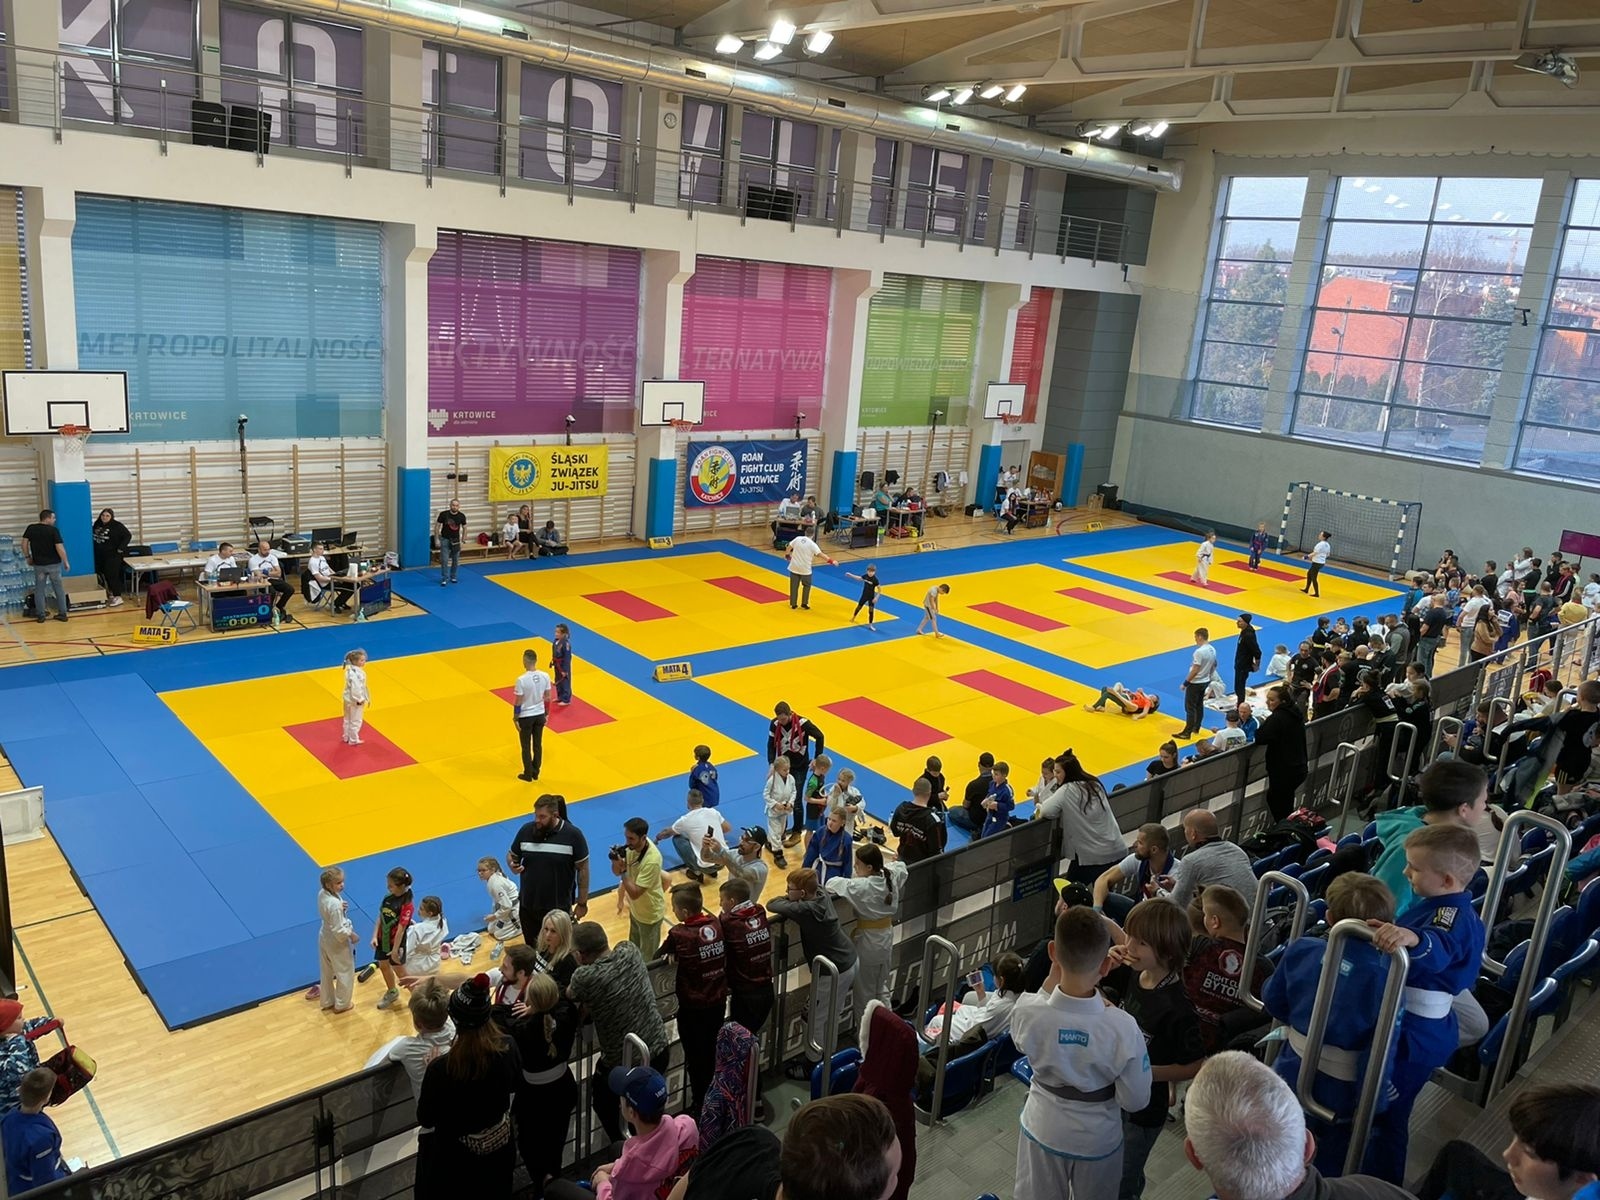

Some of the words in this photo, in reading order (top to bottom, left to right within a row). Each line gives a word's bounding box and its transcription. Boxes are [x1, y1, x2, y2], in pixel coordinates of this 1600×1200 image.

[80, 331, 381, 361] METROPOLITALNOŚĆ
[680, 347, 823, 371] LTERNATYWA
[129, 411, 188, 420] KATOWICE
[453, 410, 496, 419] KATOWICE
[551, 452, 588, 467] ŚLĄSKI
[741, 452, 764, 462] ROAN
[551, 467, 599, 479] ZWIĄZEK
[551, 480, 599, 491] JU-JITSU
[739, 474, 780, 485] KATOWICE
[140, 626, 162, 636] MATA
[162, 627, 171, 640] 5
[682, 663, 689, 676] 4
[1207, 970, 1229, 985] FIGHT
[1229, 980, 1239, 988] CL
